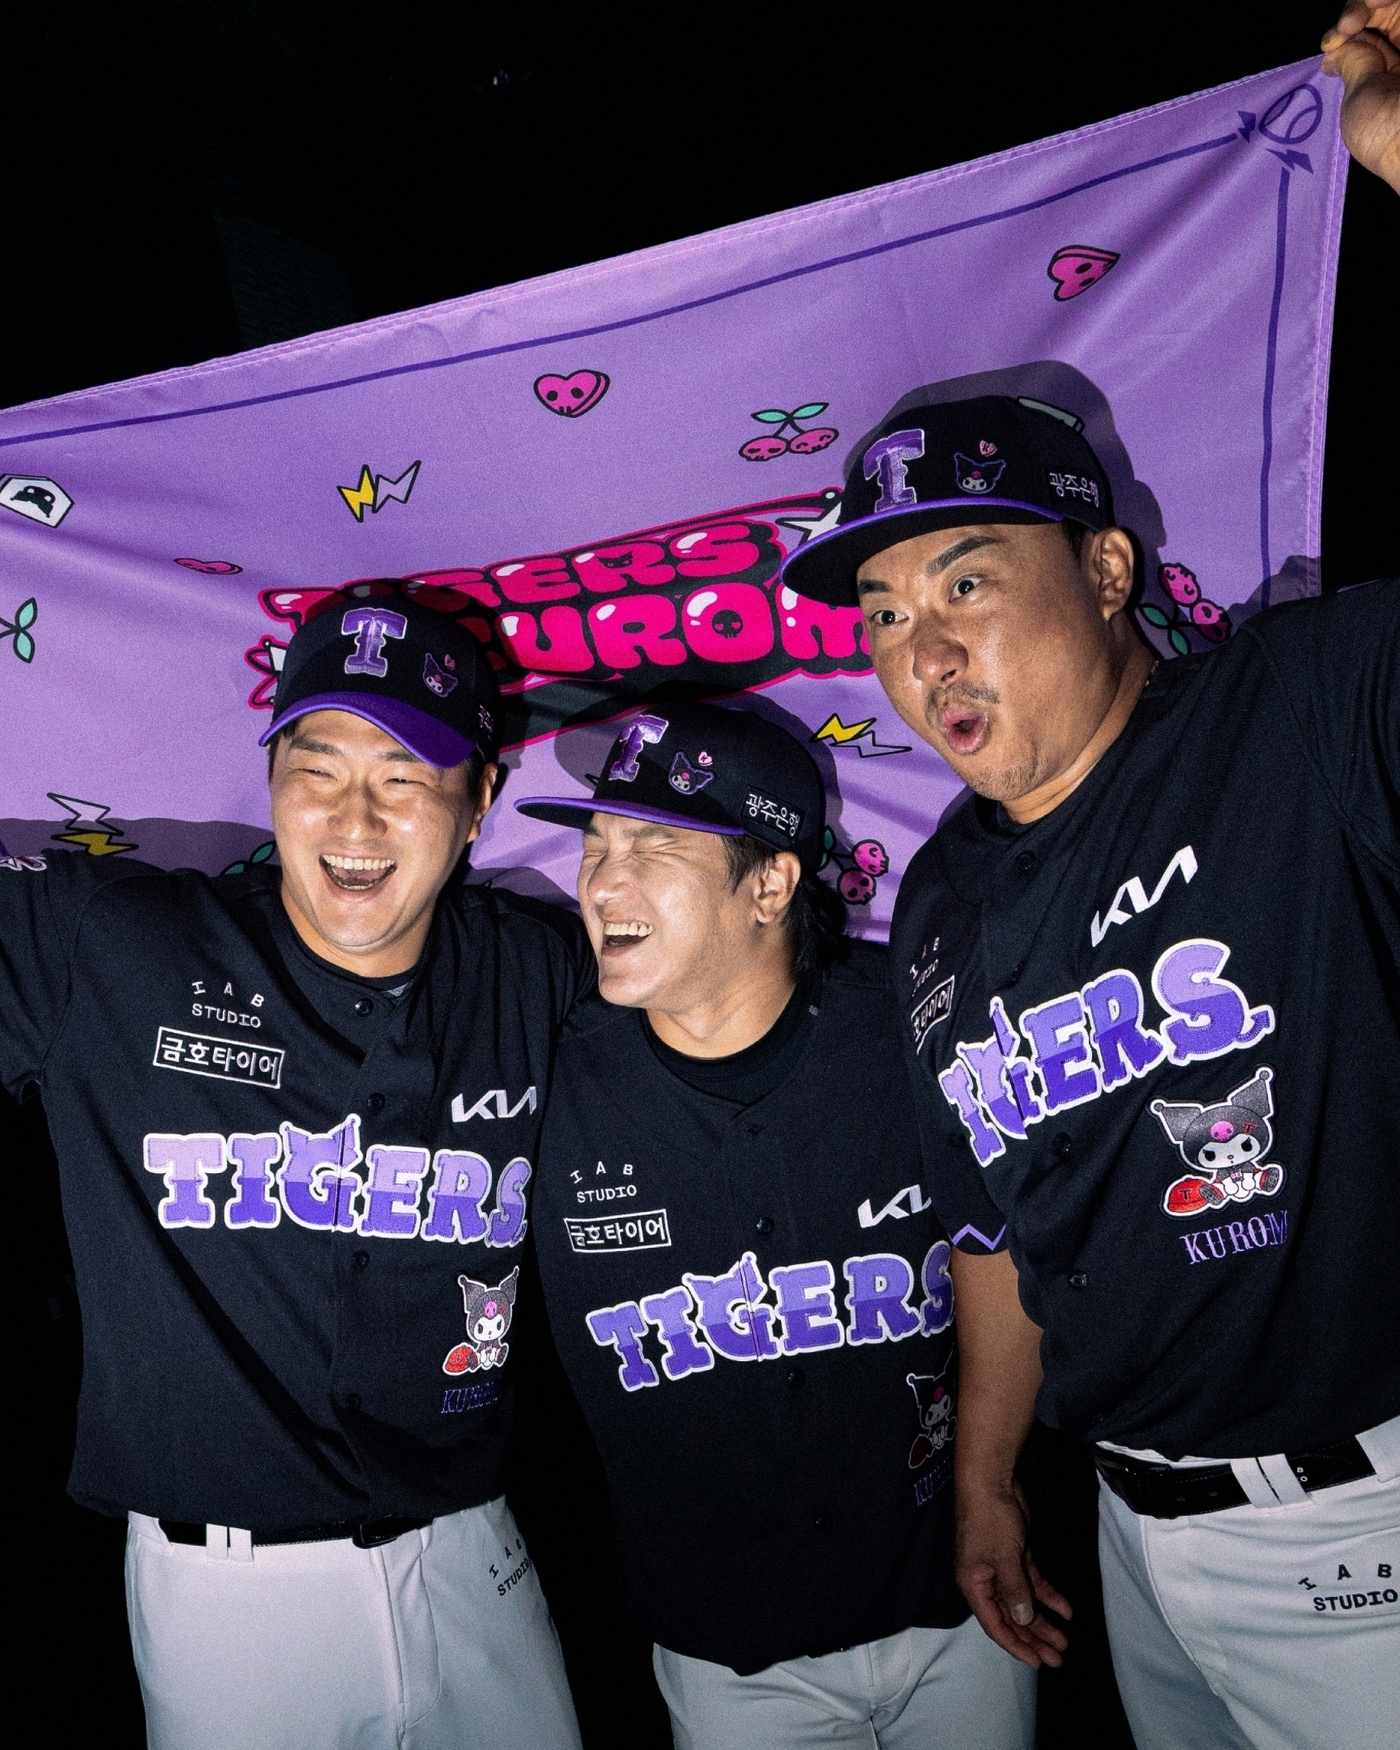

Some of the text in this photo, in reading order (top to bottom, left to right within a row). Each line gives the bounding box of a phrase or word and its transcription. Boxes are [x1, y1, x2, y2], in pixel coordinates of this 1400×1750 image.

[863, 428, 925, 513] T
[341, 606, 408, 679] T
[454, 580, 874, 676] UROM
[608, 714, 669, 782] T
[746, 793, 800, 837] 광주은행
[192, 1003, 261, 1028] STUDIO
[161, 1037, 278, 1080] 금호타이어
[938, 938, 1275, 1167] IGERS
[143, 1113, 532, 1248] TIGERS
[576, 1185, 637, 1203] STUDIO
[858, 1184, 932, 1229] KI
[570, 1217, 666, 1247] 금호타이어
[586, 1240, 956, 1392] TIGERS
[1312, 1588, 1399, 1612] STUDIO
